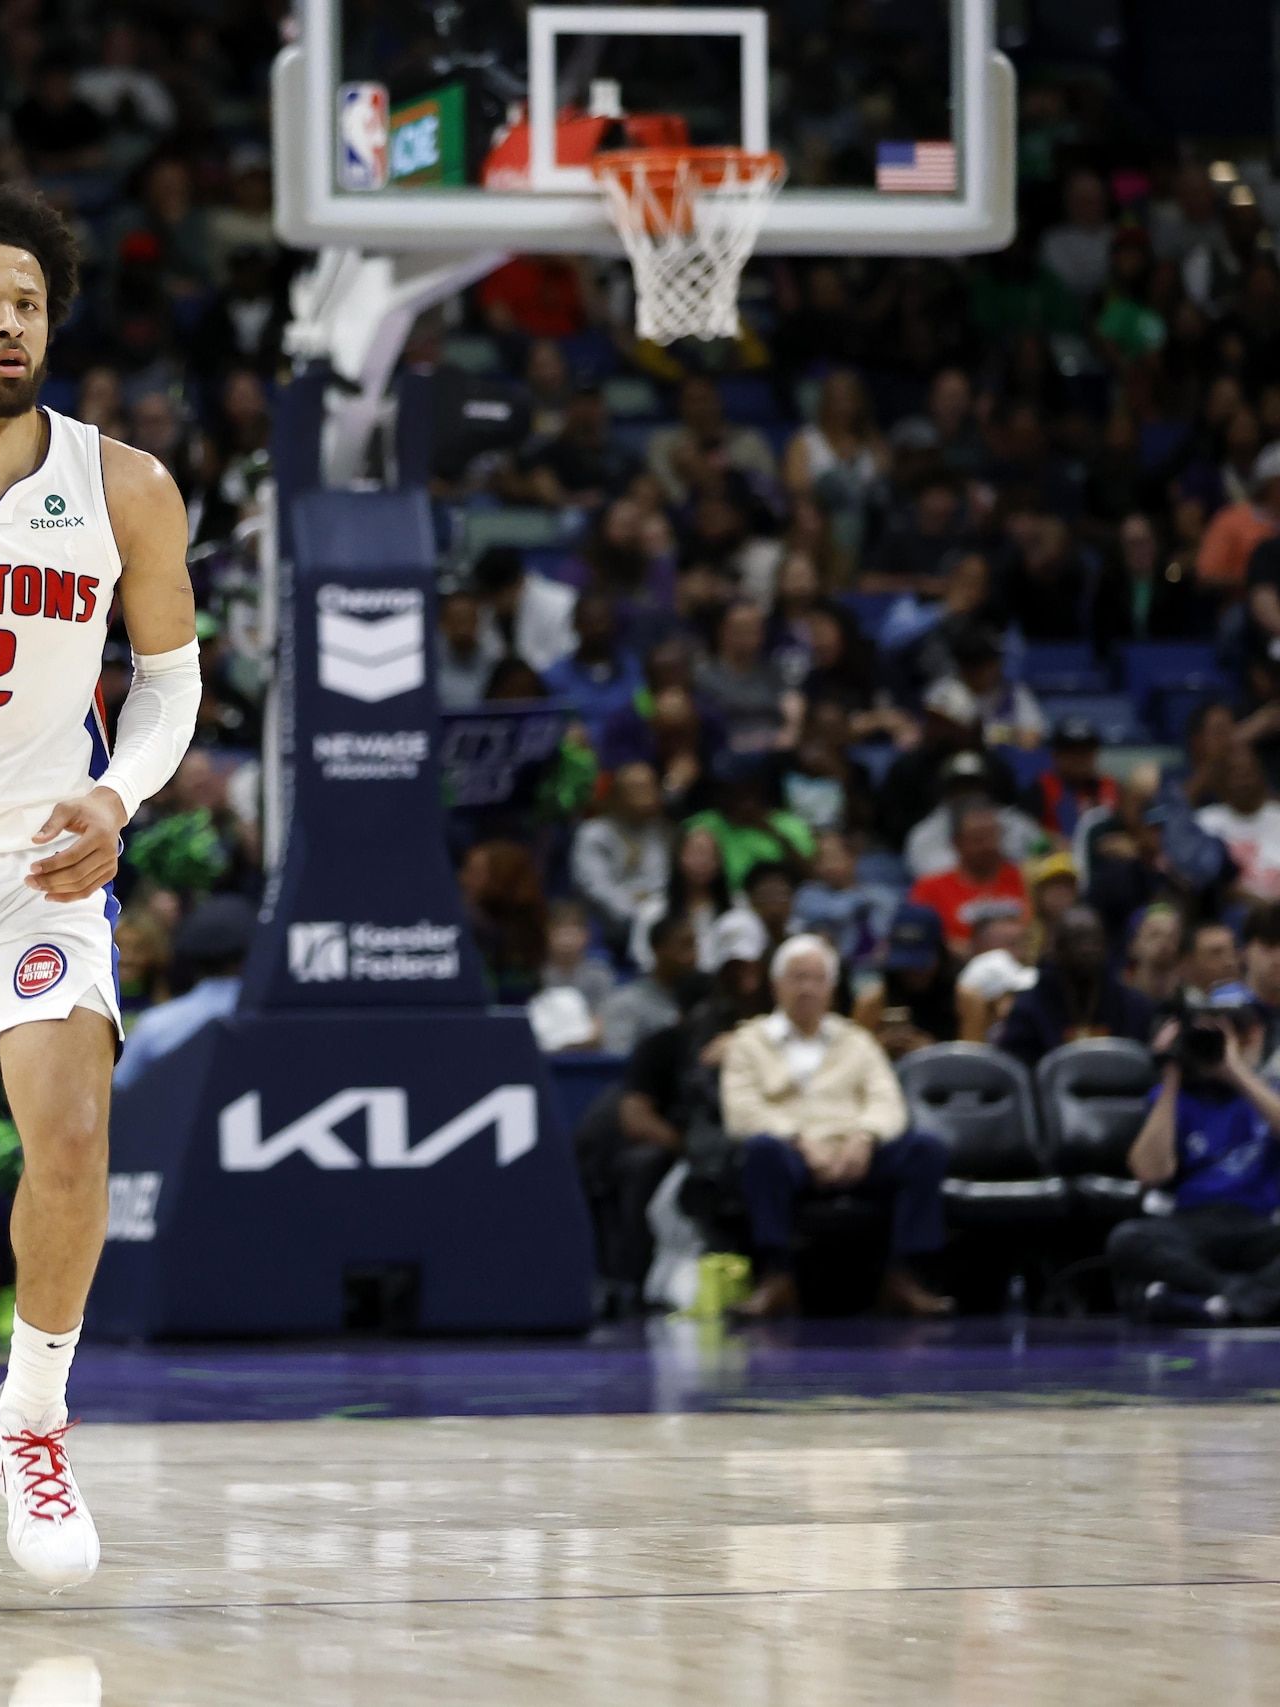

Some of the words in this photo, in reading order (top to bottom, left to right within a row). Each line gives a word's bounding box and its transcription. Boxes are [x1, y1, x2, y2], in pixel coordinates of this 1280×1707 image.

[30, 516, 85, 530] StockX
[24, 961, 56, 974] DETROIT
[22, 970, 54, 983] PISTONS
[220, 1084, 538, 1172] KIA
